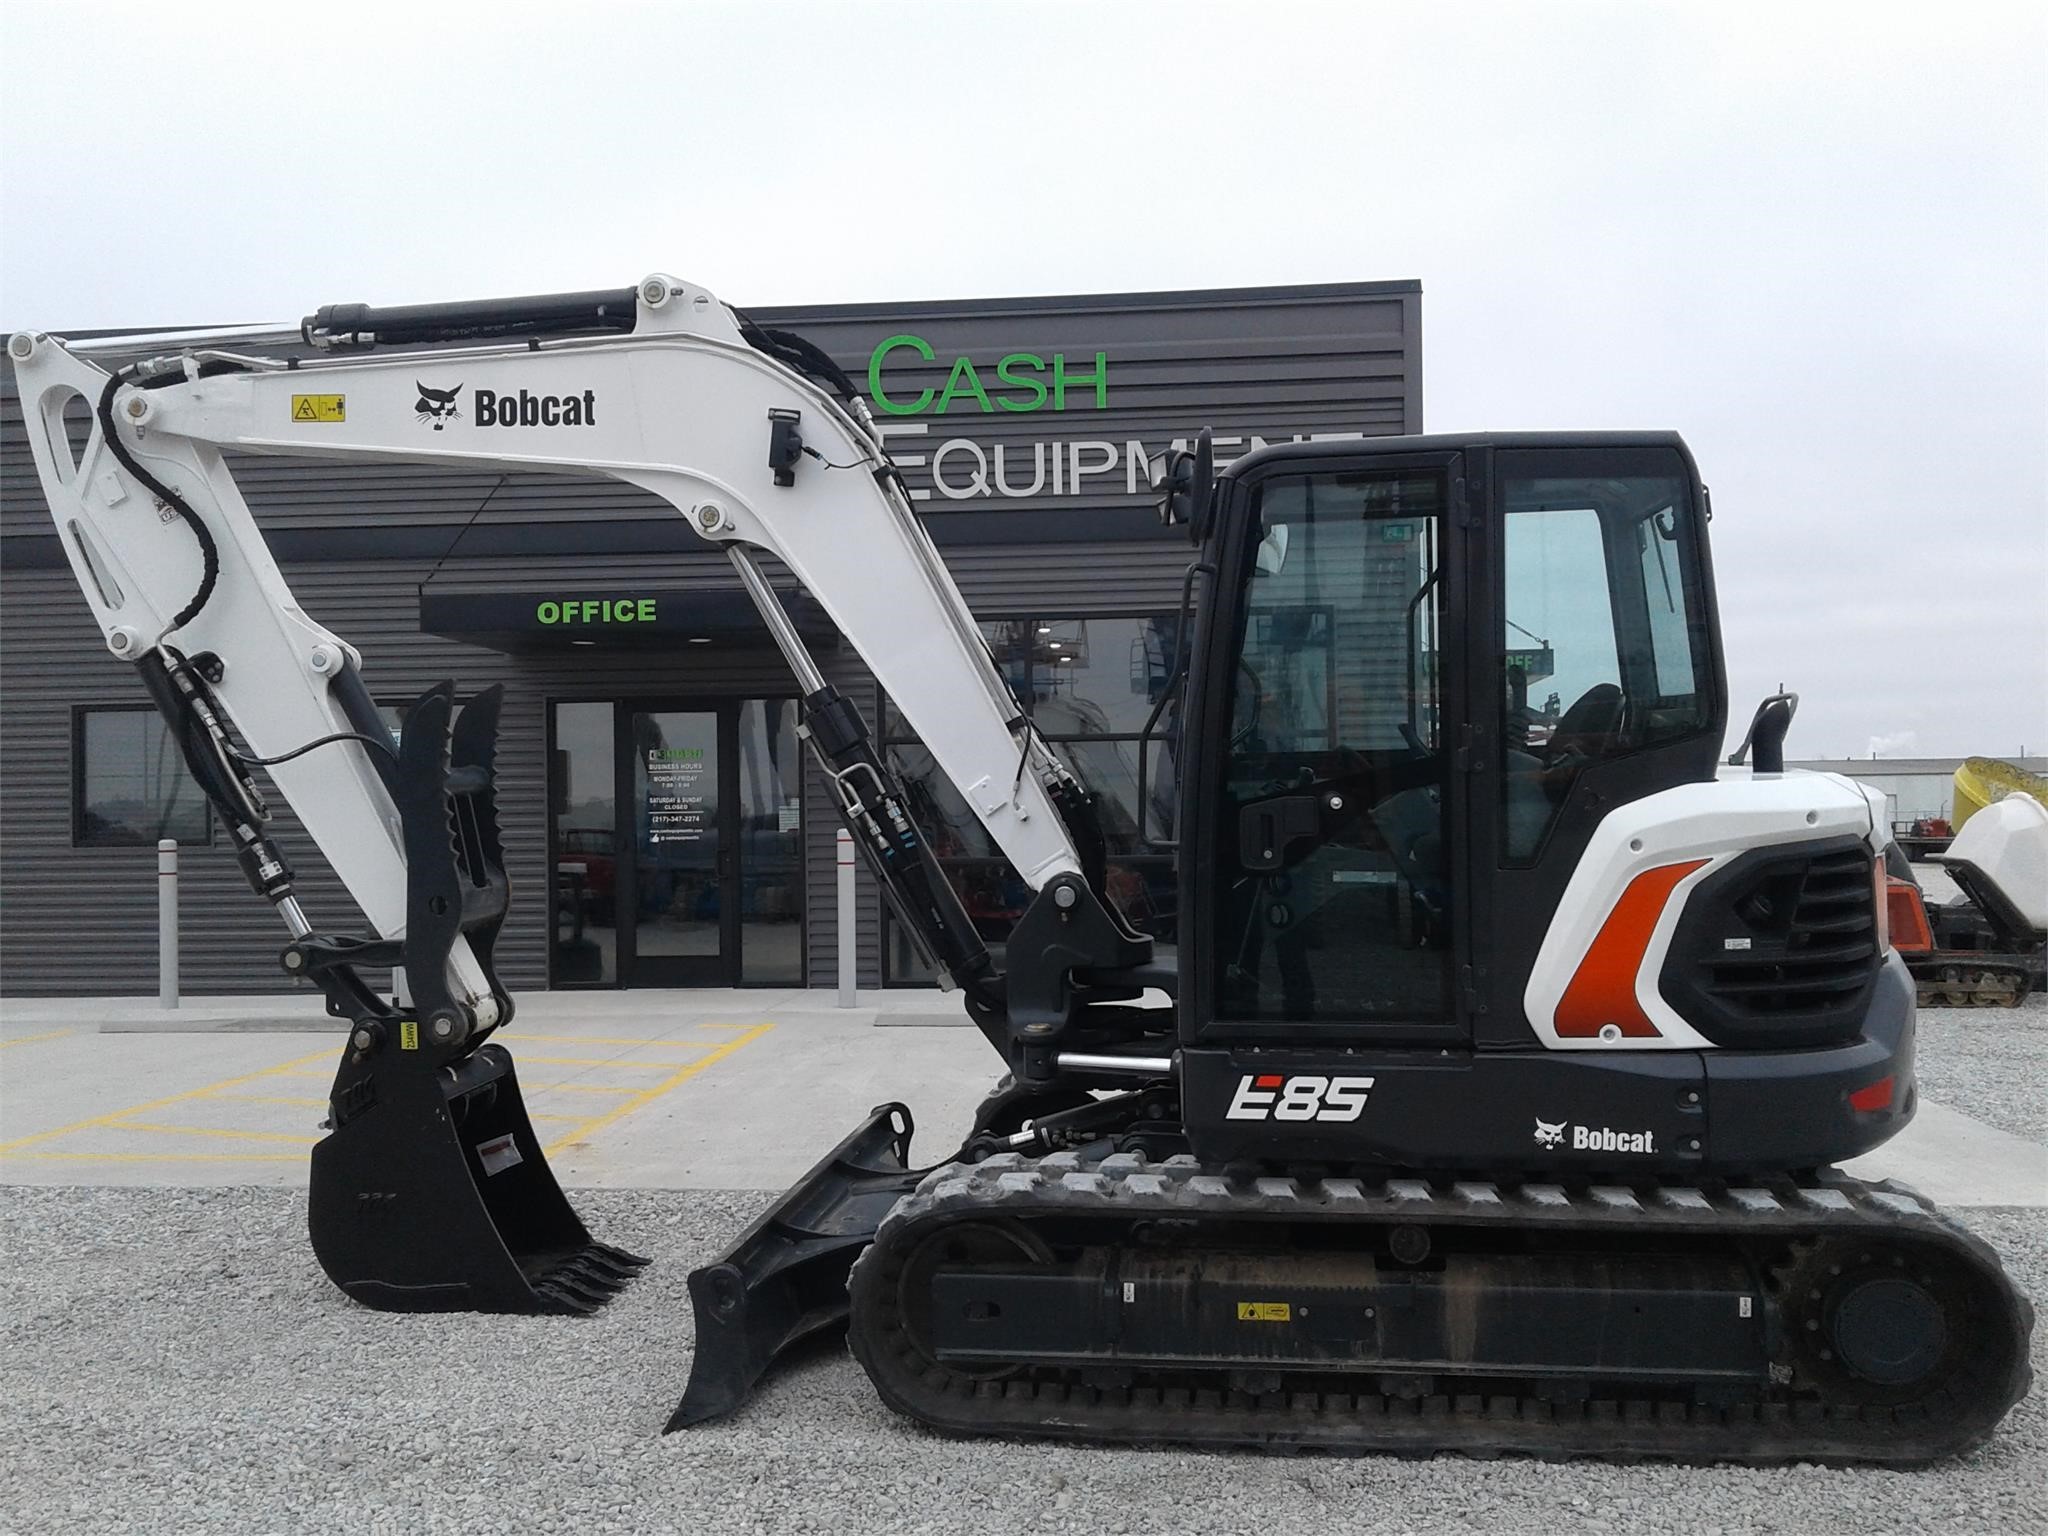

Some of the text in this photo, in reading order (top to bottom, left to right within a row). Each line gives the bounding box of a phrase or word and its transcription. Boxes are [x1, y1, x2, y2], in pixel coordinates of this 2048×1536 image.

[868, 334, 1107, 415] CASH
[475, 389, 596, 427] Bobcat
[875, 423, 1364, 500] EQUIPME
[537, 599, 657, 624] OFFICE
[1225, 1075, 1376, 1121] E85
[1573, 1125, 1654, 1154] Bobcat
